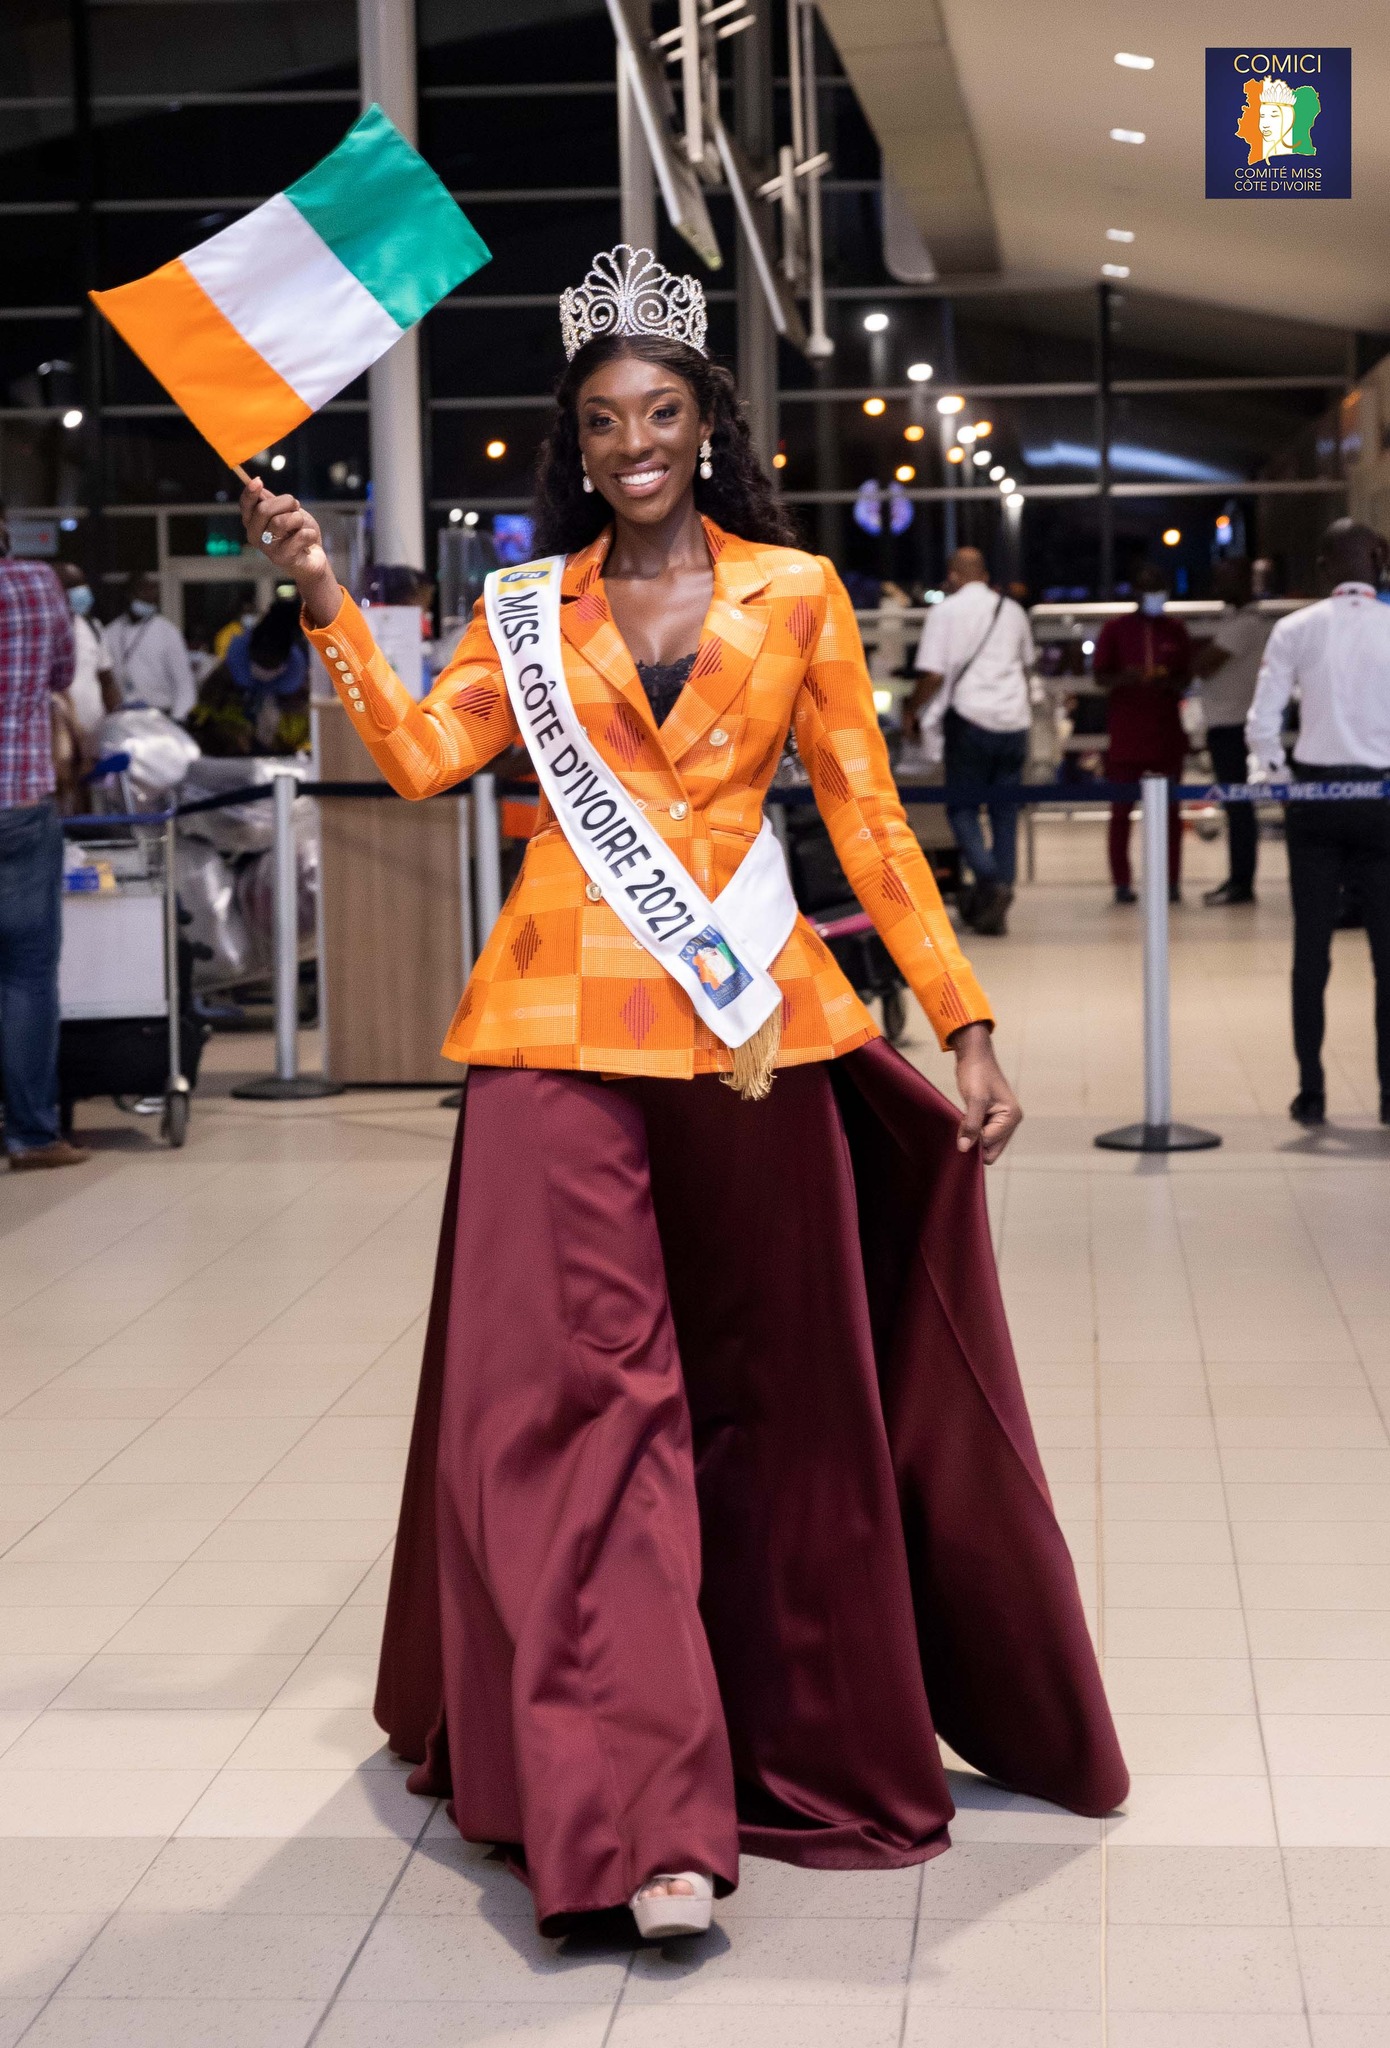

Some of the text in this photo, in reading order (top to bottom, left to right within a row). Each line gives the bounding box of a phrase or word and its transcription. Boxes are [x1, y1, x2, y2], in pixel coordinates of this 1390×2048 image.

[497, 590, 696, 944] MISS CÔTE D'IVOIRE 2021
[1288, 782, 1384, 800] WELCOME
